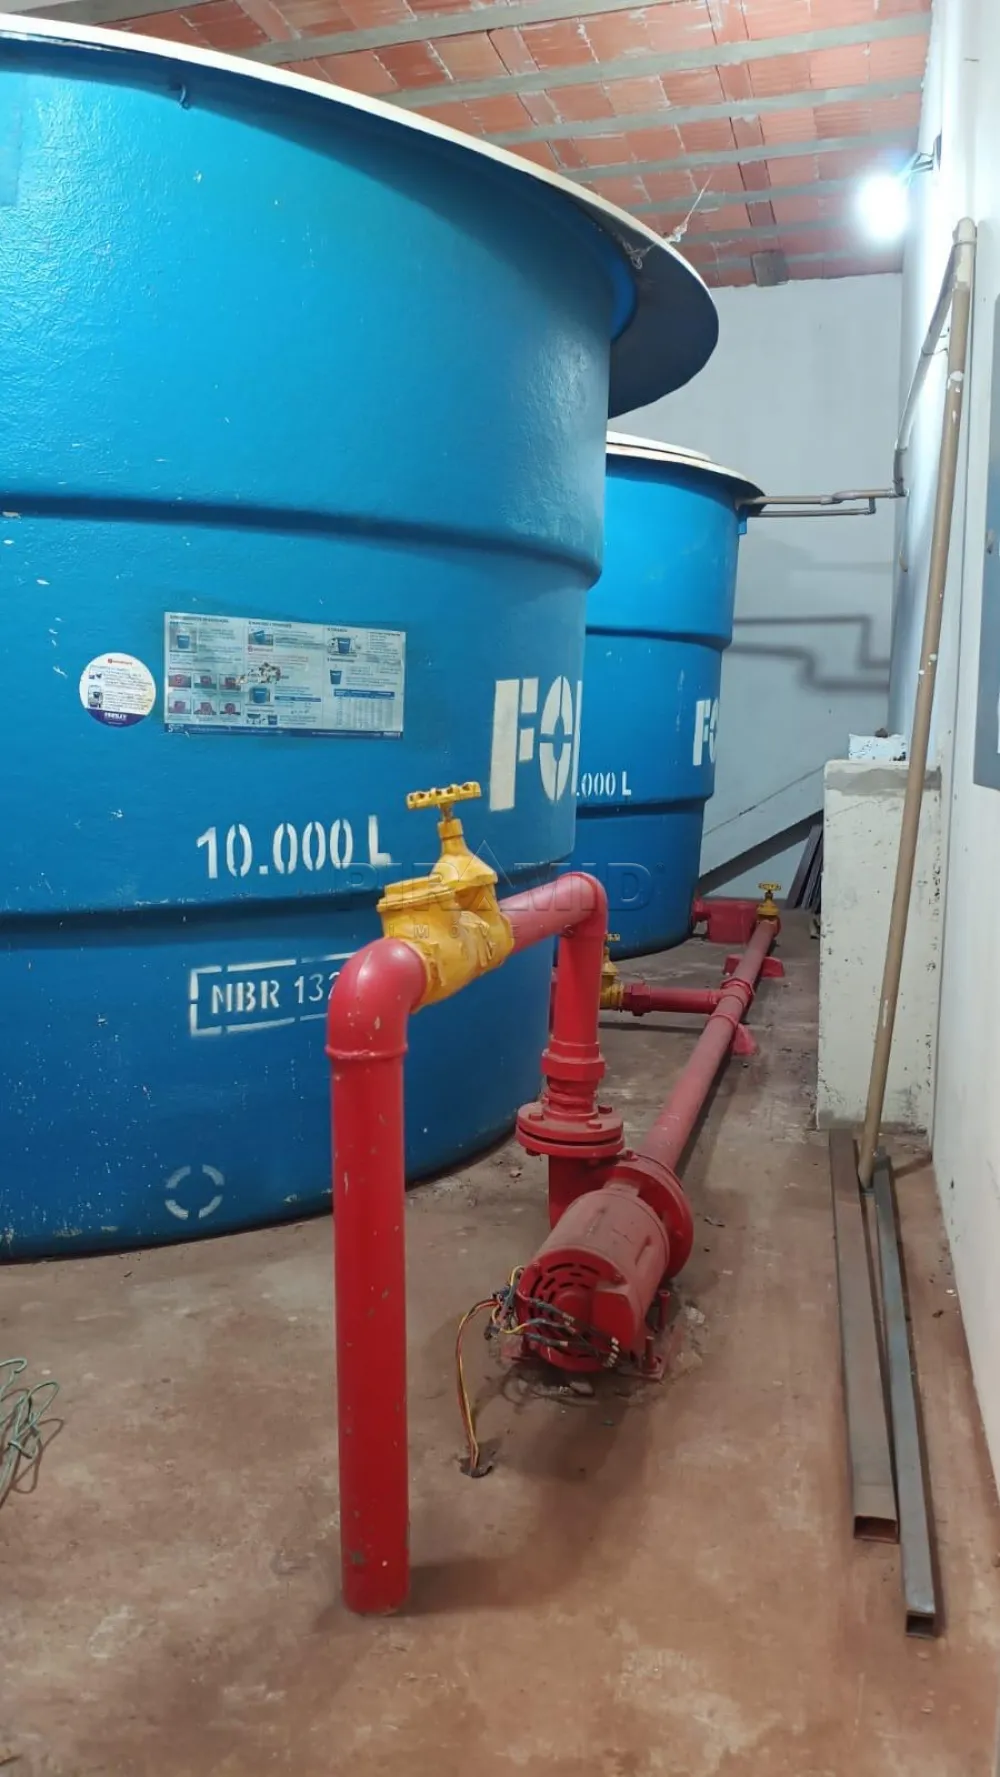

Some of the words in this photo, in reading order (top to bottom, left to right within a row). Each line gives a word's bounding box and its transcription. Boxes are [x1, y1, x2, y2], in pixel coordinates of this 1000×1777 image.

[621, 771, 632, 796] L
[196, 818, 353, 879] 10.000
[367, 814, 392, 866] L
[211, 980, 280, 1014] NBR
